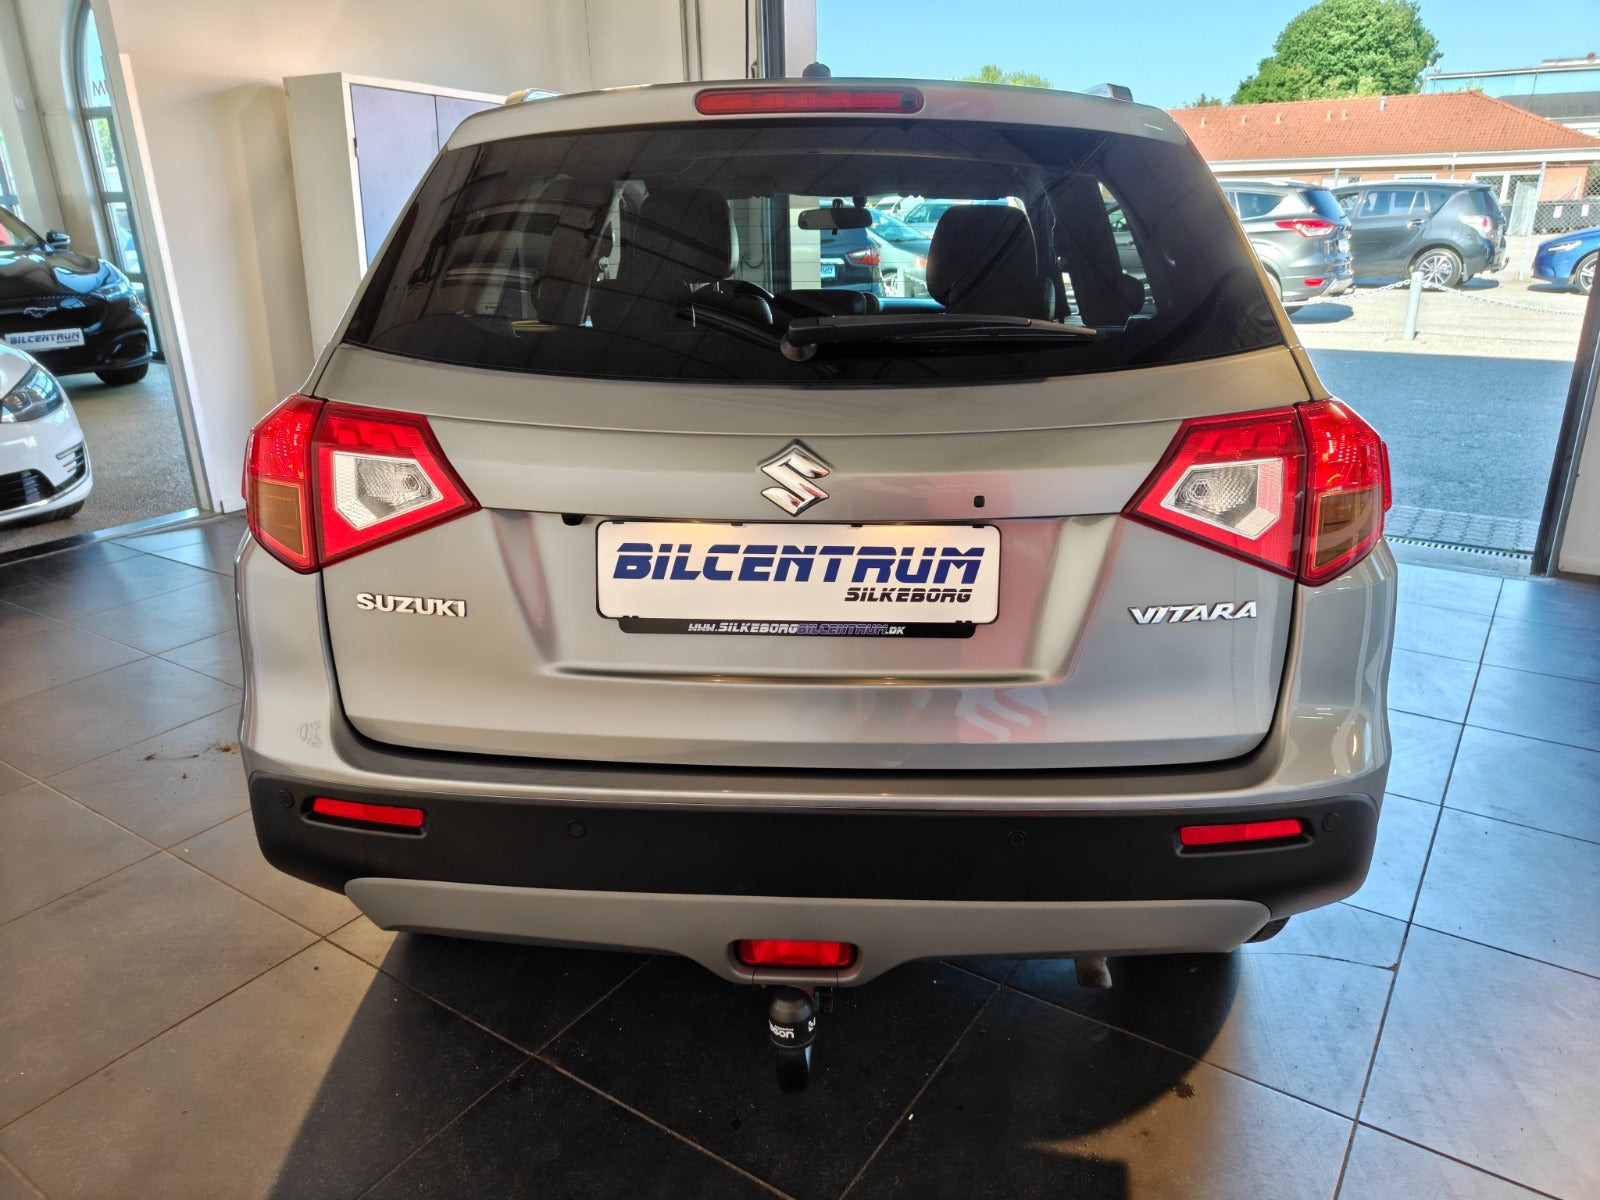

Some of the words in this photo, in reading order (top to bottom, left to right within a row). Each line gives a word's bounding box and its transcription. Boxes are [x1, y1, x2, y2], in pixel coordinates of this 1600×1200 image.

[10, 331, 80, 346] BILCENTRUM
[613, 542, 985, 584] BILCENTRUM
[356, 591, 466, 618] SUZUKI
[844, 587, 973, 603] SILKEBORG
[1128, 599, 1257, 625] VITARA
